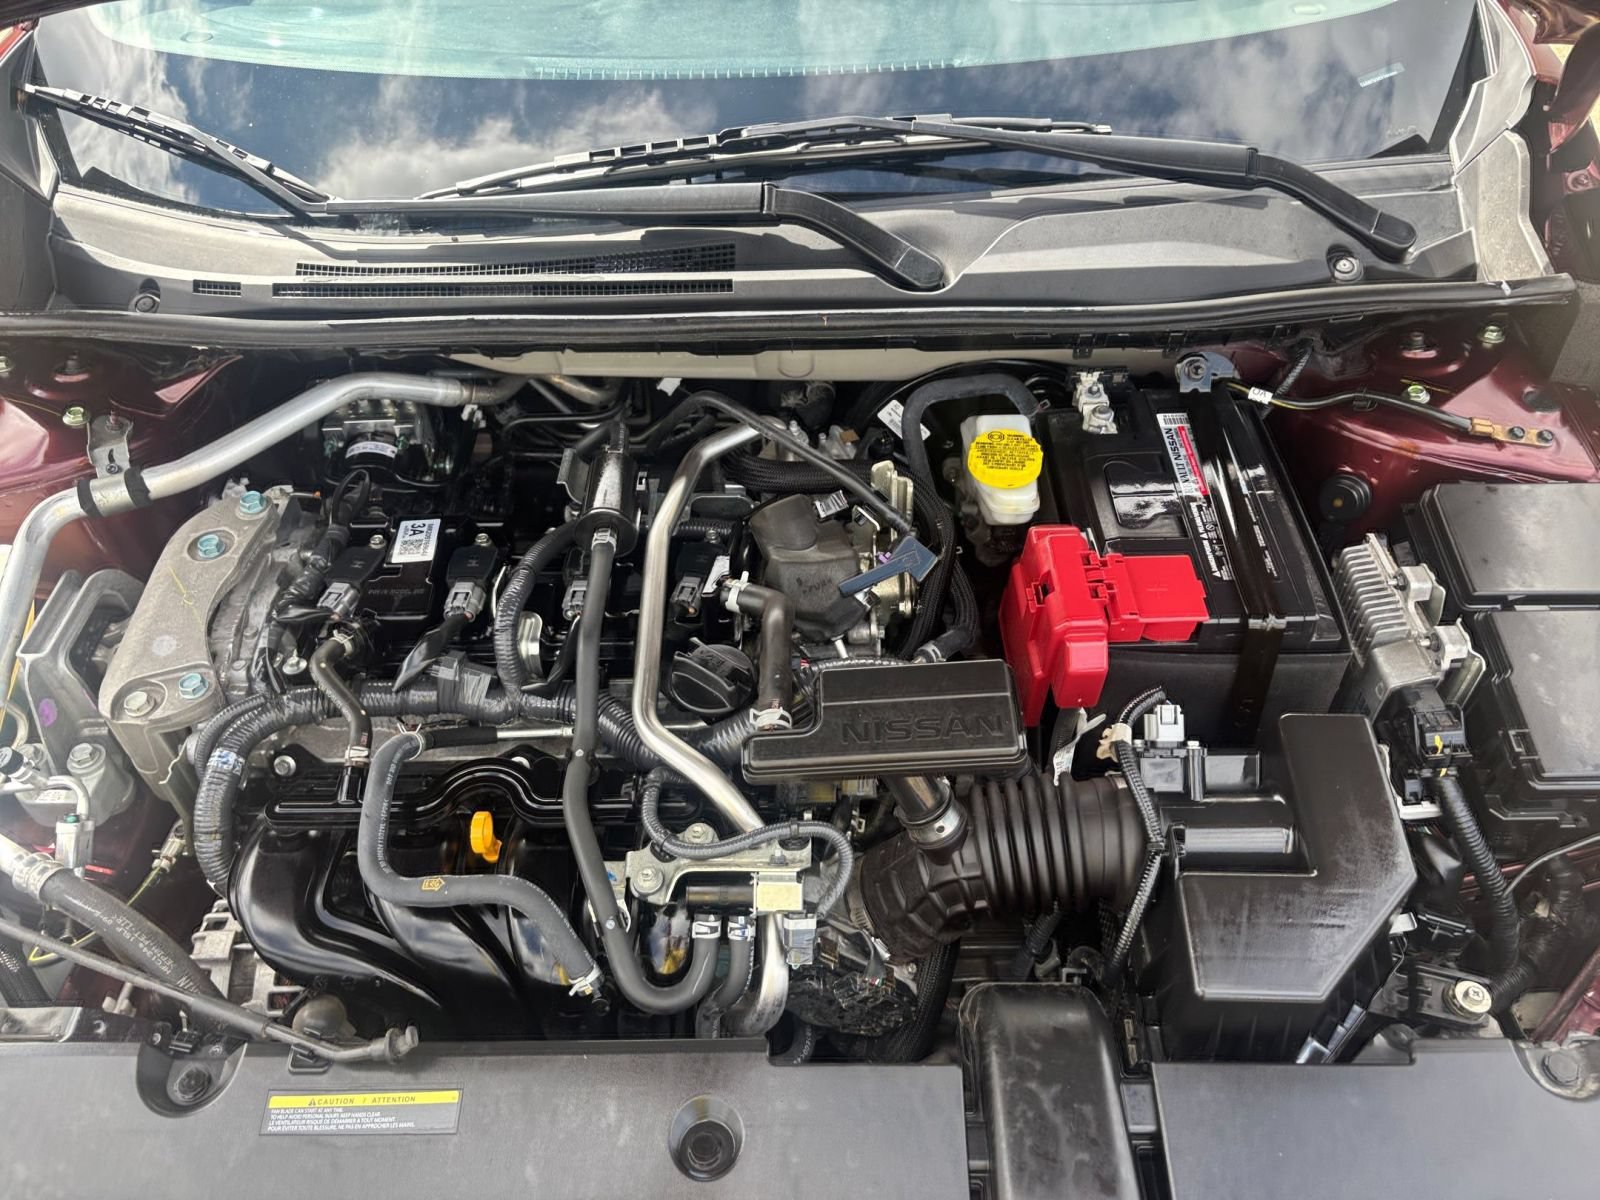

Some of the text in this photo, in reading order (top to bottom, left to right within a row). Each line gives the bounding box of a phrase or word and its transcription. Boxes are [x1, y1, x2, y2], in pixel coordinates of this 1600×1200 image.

[1164, 428, 1182, 460] NISSAN
[409, 523, 426, 537] 3A
[841, 714, 1005, 745] NISSAN
[317, 1097, 355, 1105] CAUTION
[371, 1096, 416, 1104] ATTENTION
